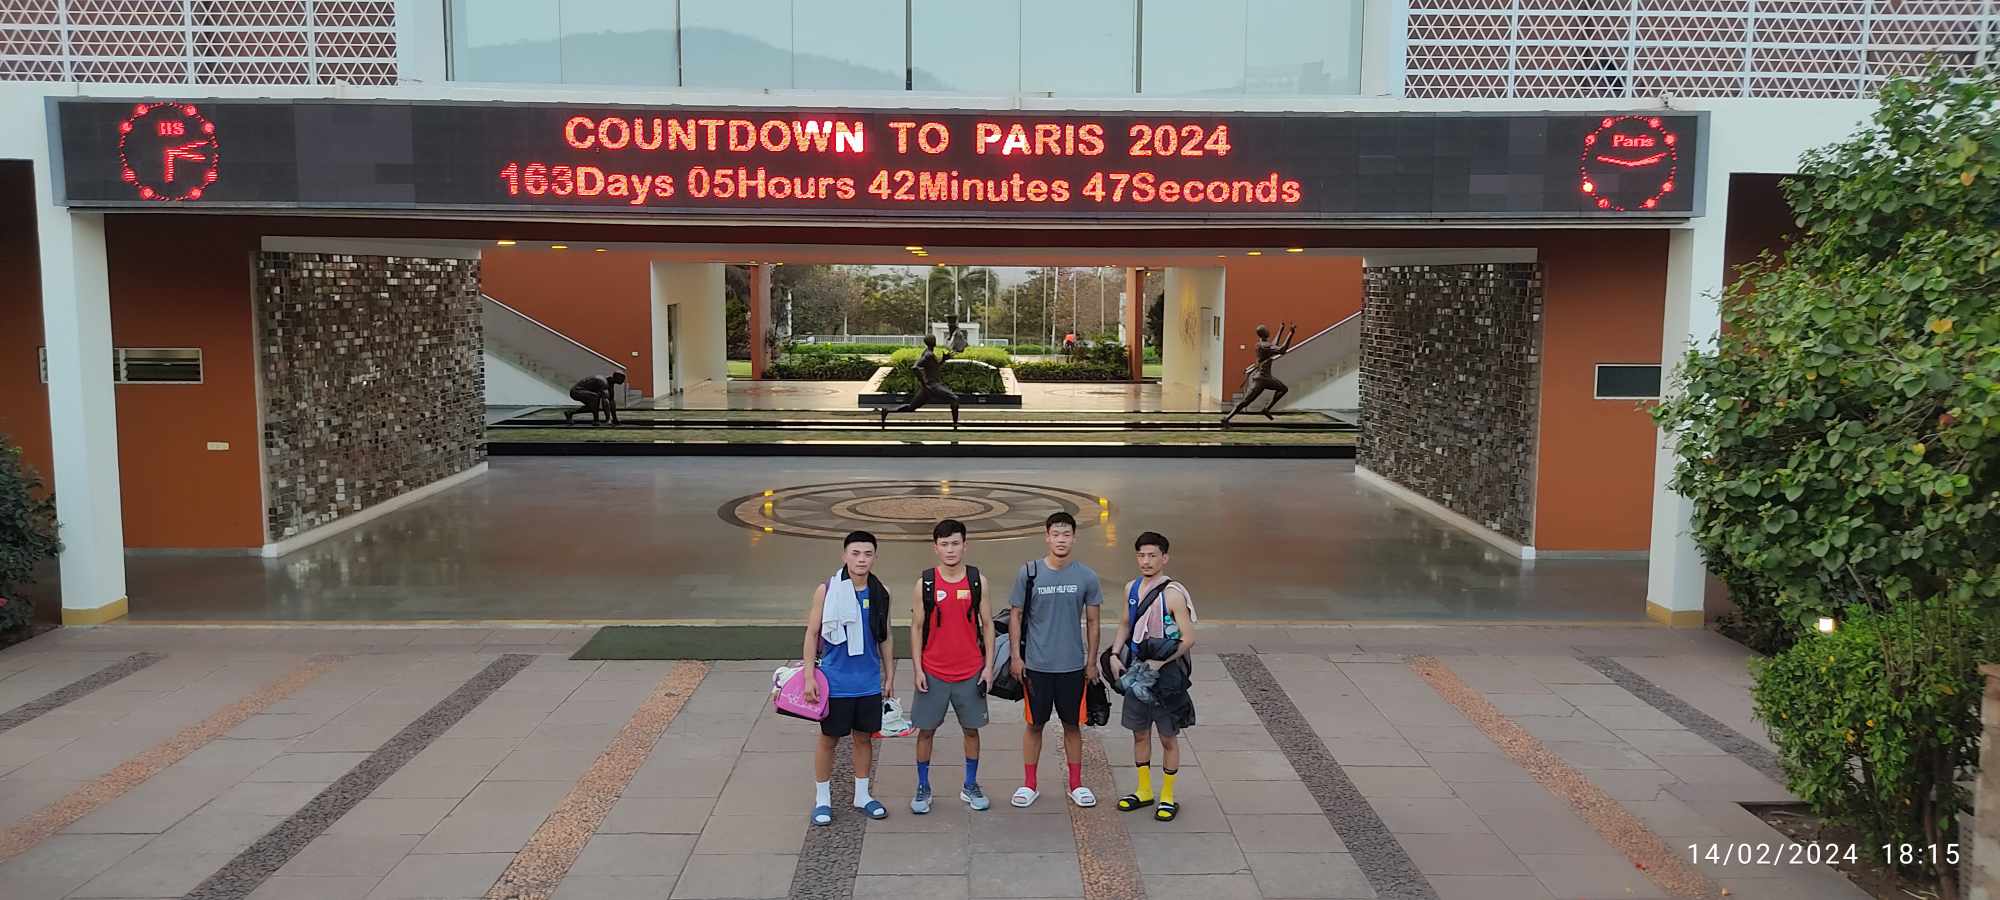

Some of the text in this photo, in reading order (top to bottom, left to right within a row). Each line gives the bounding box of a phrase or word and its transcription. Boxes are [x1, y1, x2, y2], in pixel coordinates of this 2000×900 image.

[160, 121, 184, 135] IIS
[565, 116, 1231, 157] COUNTDOWN TO PARIS 2024
[1612, 134, 1655, 147] Paris
[501, 164, 1301, 204] 163Days 05Hours 42Minutes 47Seconds
